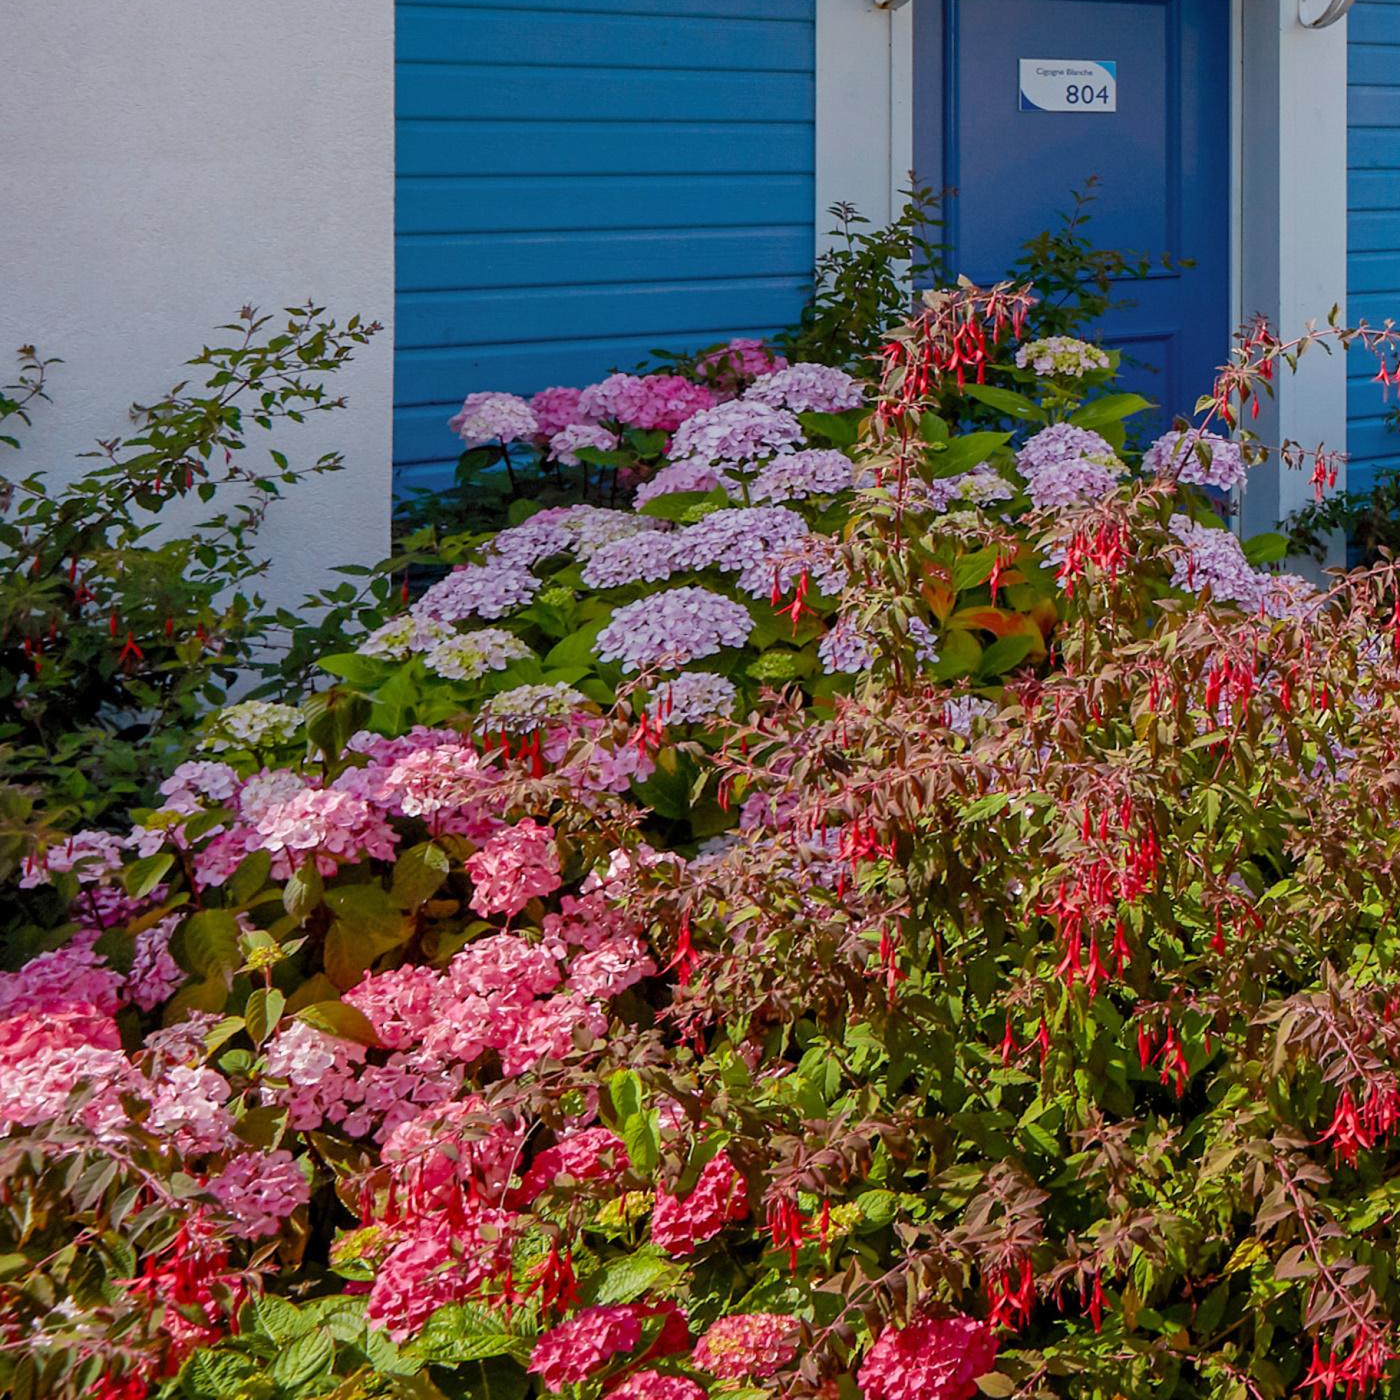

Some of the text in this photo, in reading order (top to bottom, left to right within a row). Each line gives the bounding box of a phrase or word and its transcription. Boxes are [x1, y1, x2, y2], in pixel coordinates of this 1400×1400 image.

[1036, 67, 1093, 77] Cigogne Blanche
[1066, 84, 1109, 104] 804
